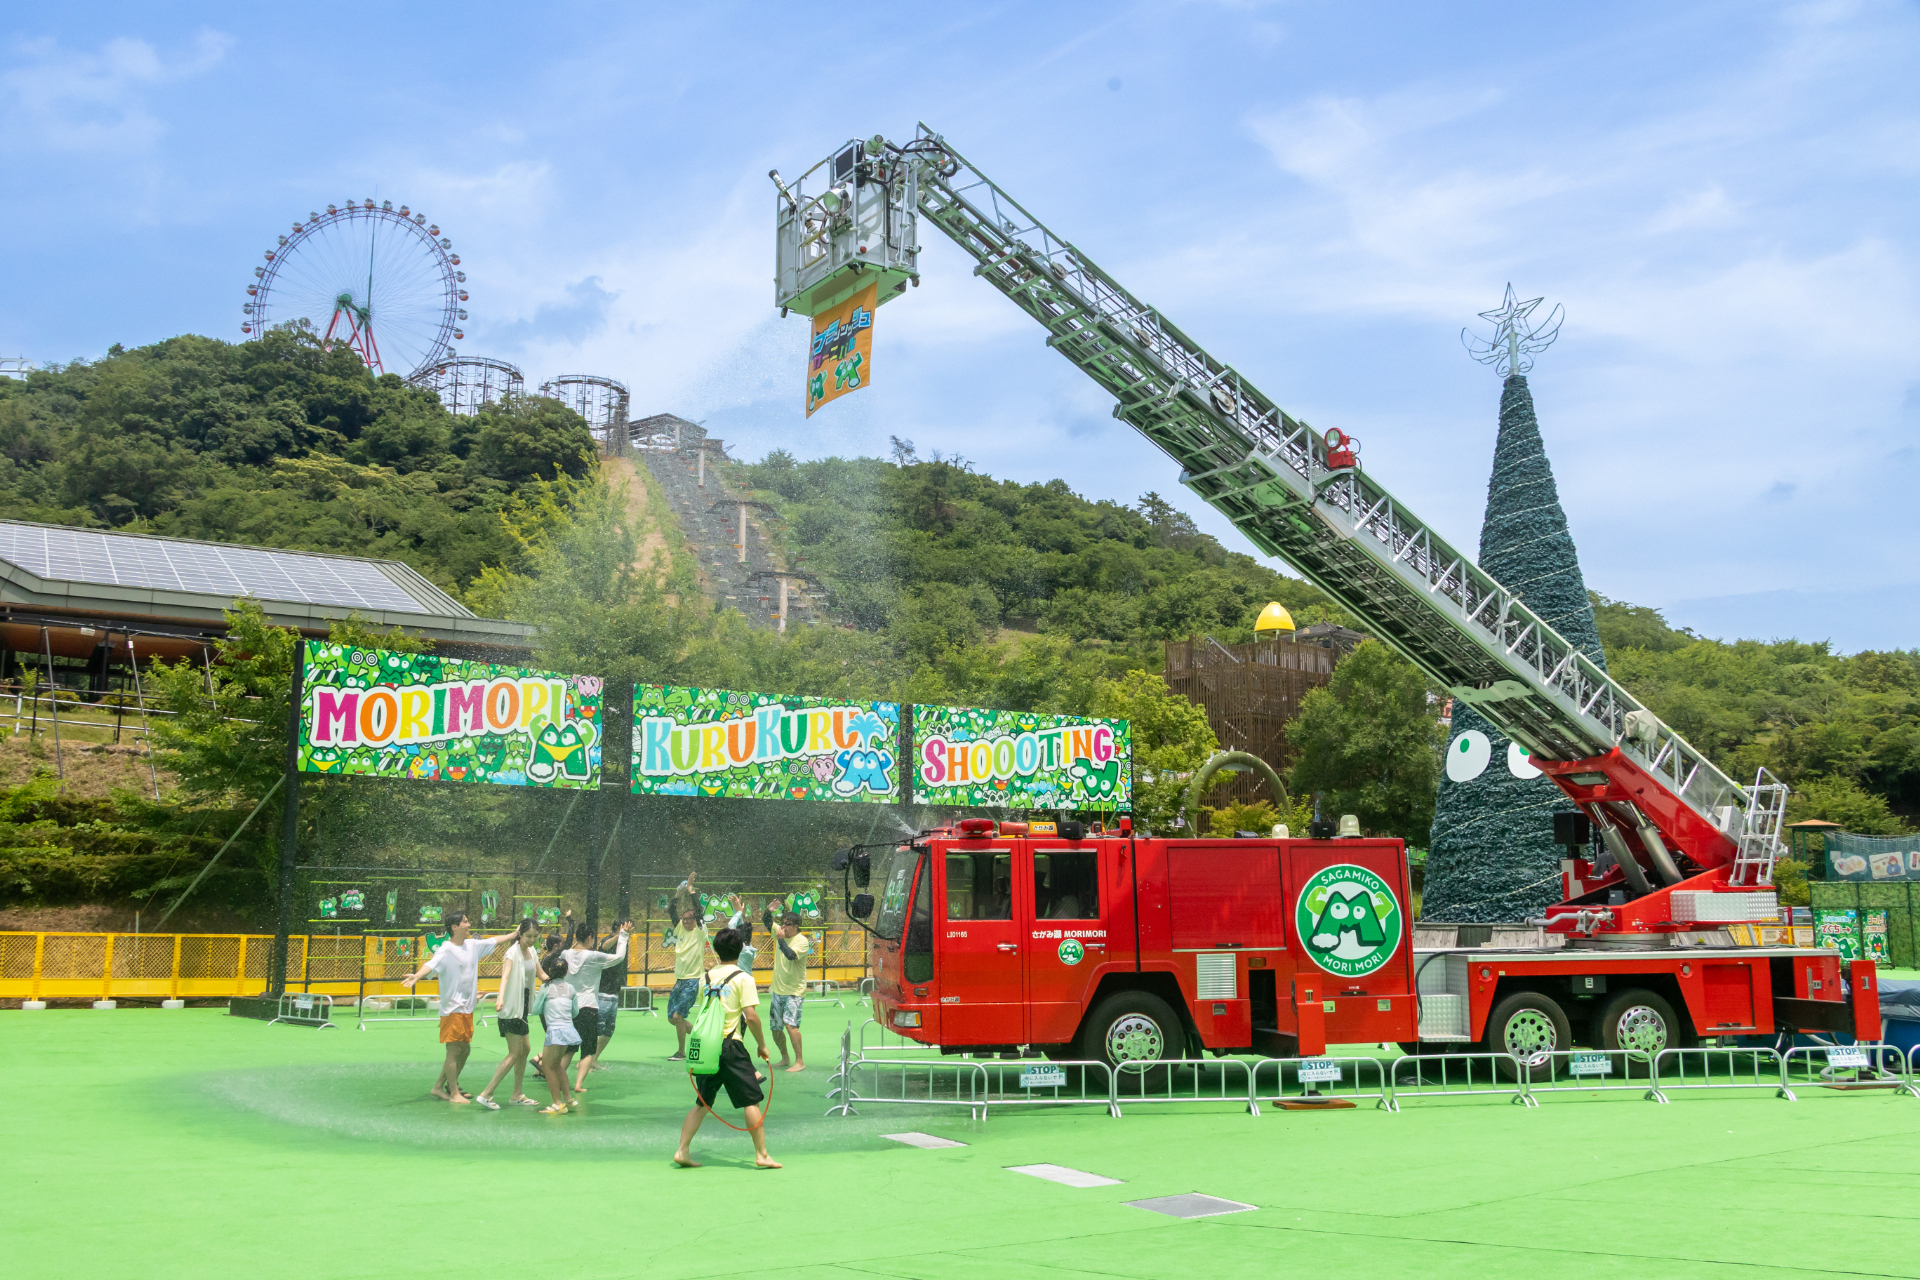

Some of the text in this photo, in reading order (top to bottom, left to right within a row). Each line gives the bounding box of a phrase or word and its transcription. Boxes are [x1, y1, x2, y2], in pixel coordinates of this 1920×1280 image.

[315, 682, 562, 742] MORIMORI
[645, 708, 860, 771] KURUKURU
[924, 728, 1112, 783] SHOOOTING
[1321, 870, 1379, 890] SAGAMIKO
[1031, 929, 1107, 939] さがみ湖 MORIMORI
[1323, 952, 1383, 972] MORI MORI
[689, 1049, 699, 1059] 20
[1835, 1047, 1857, 1056] STOP
[1580, 1054, 1604, 1063] STOP
[1031, 1065, 1057, 1074] STOP
[1307, 1060, 1332, 1070] STOP
